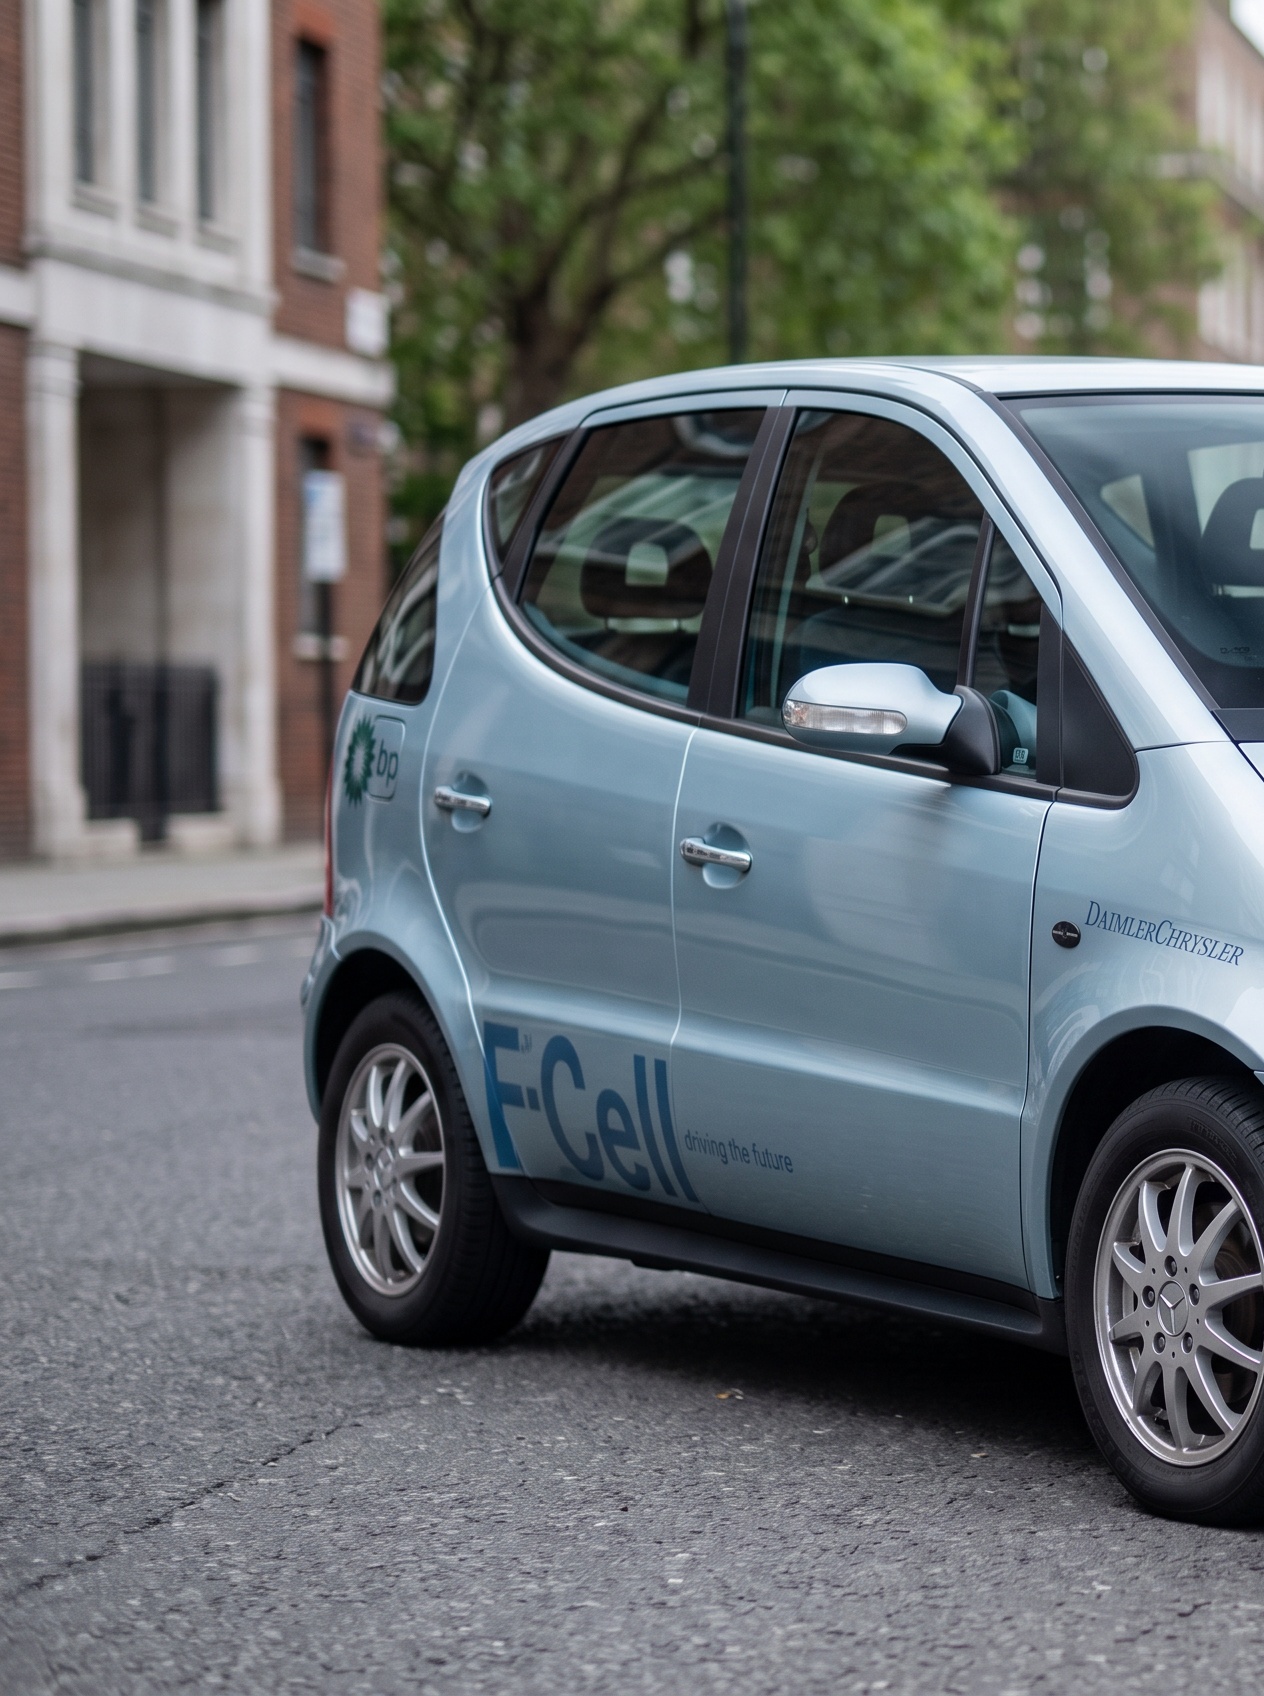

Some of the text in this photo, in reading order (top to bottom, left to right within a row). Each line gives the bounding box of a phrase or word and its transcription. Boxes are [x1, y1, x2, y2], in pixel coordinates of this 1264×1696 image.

[376, 738, 399, 788] bp
[483, 1021, 700, 1203] F-Cell
[684, 1129, 794, 1174] driving the future
